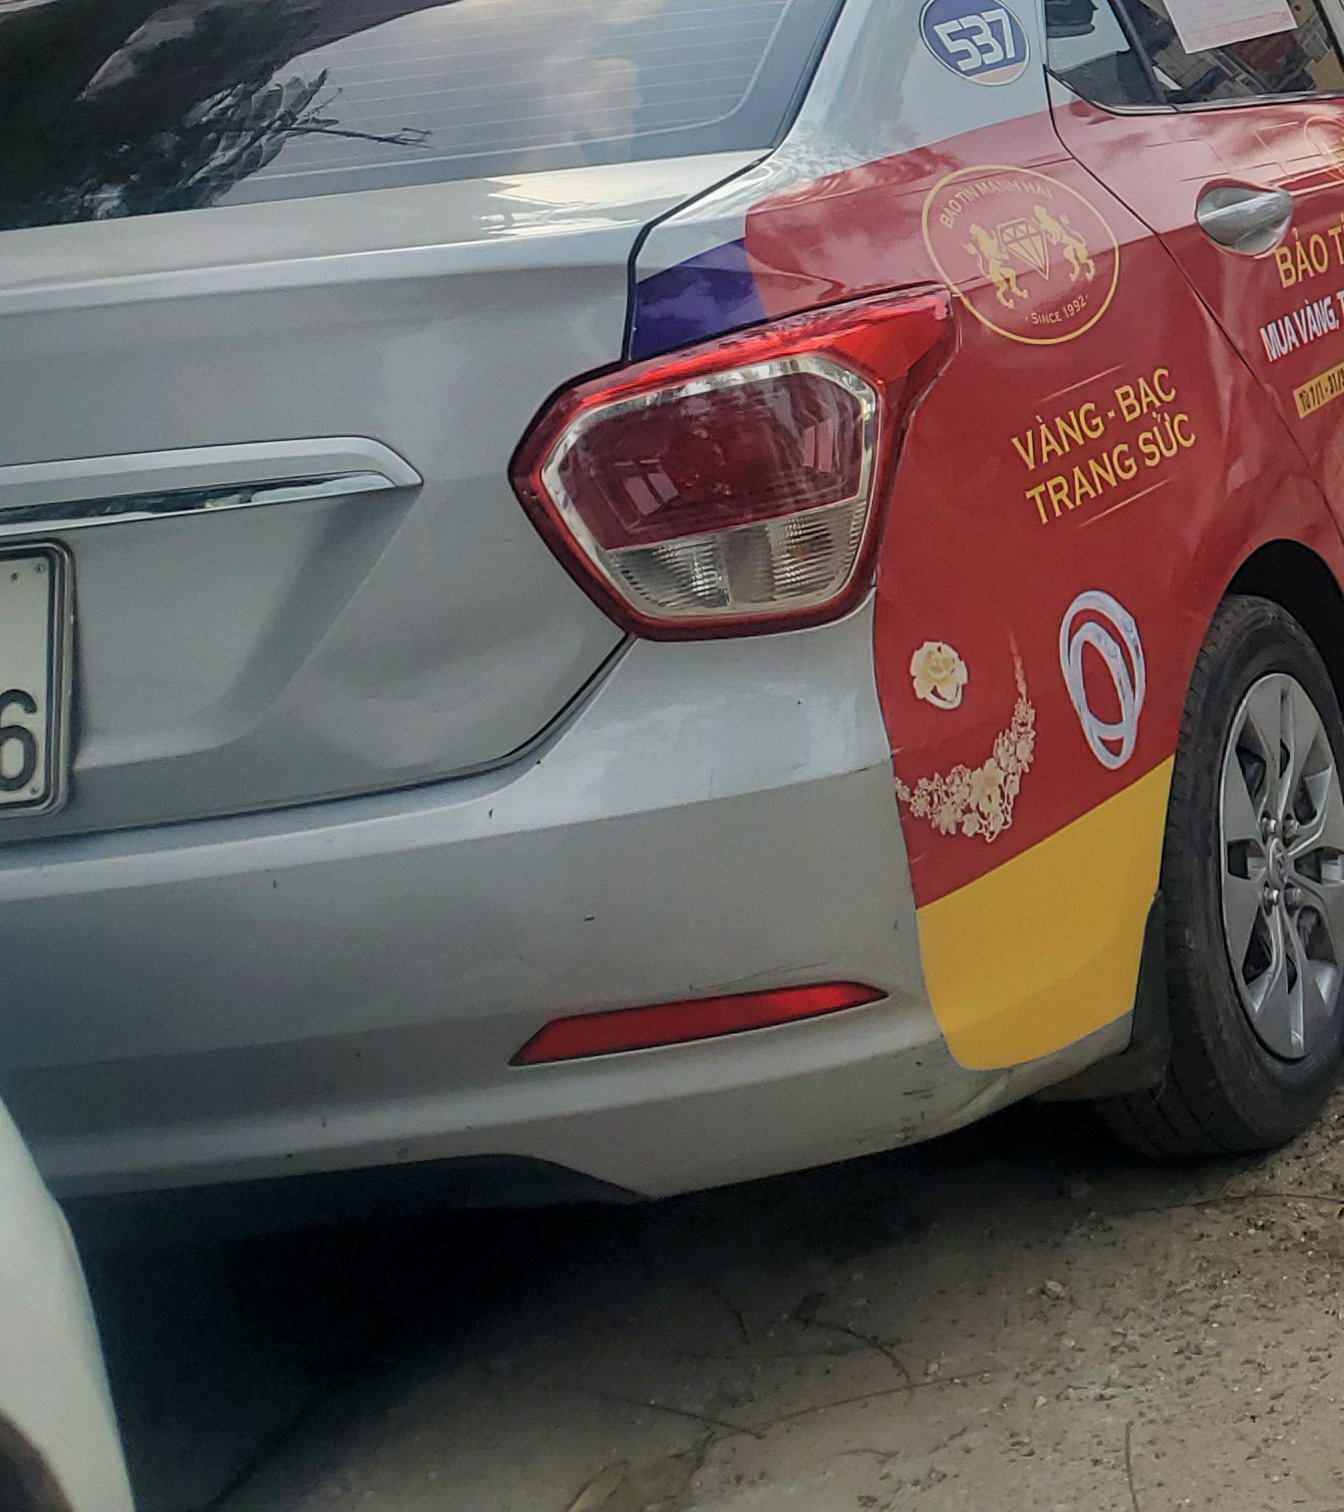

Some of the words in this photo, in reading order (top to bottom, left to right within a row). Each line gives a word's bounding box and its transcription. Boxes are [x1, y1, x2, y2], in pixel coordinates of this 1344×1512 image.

[933, 8, 1016, 71] 537
[1274, 227, 1329, 288] BẢO
[1063, 295, 1087, 318] 1992
[1259, 316, 1300, 362] MUA
[1011, 403, 1105, 471] VÀNG
[1115, 367, 1176, 423] BẠC
[1025, 444, 1138, 525] TRANG
[1138, 412, 1196, 467] SỨC
